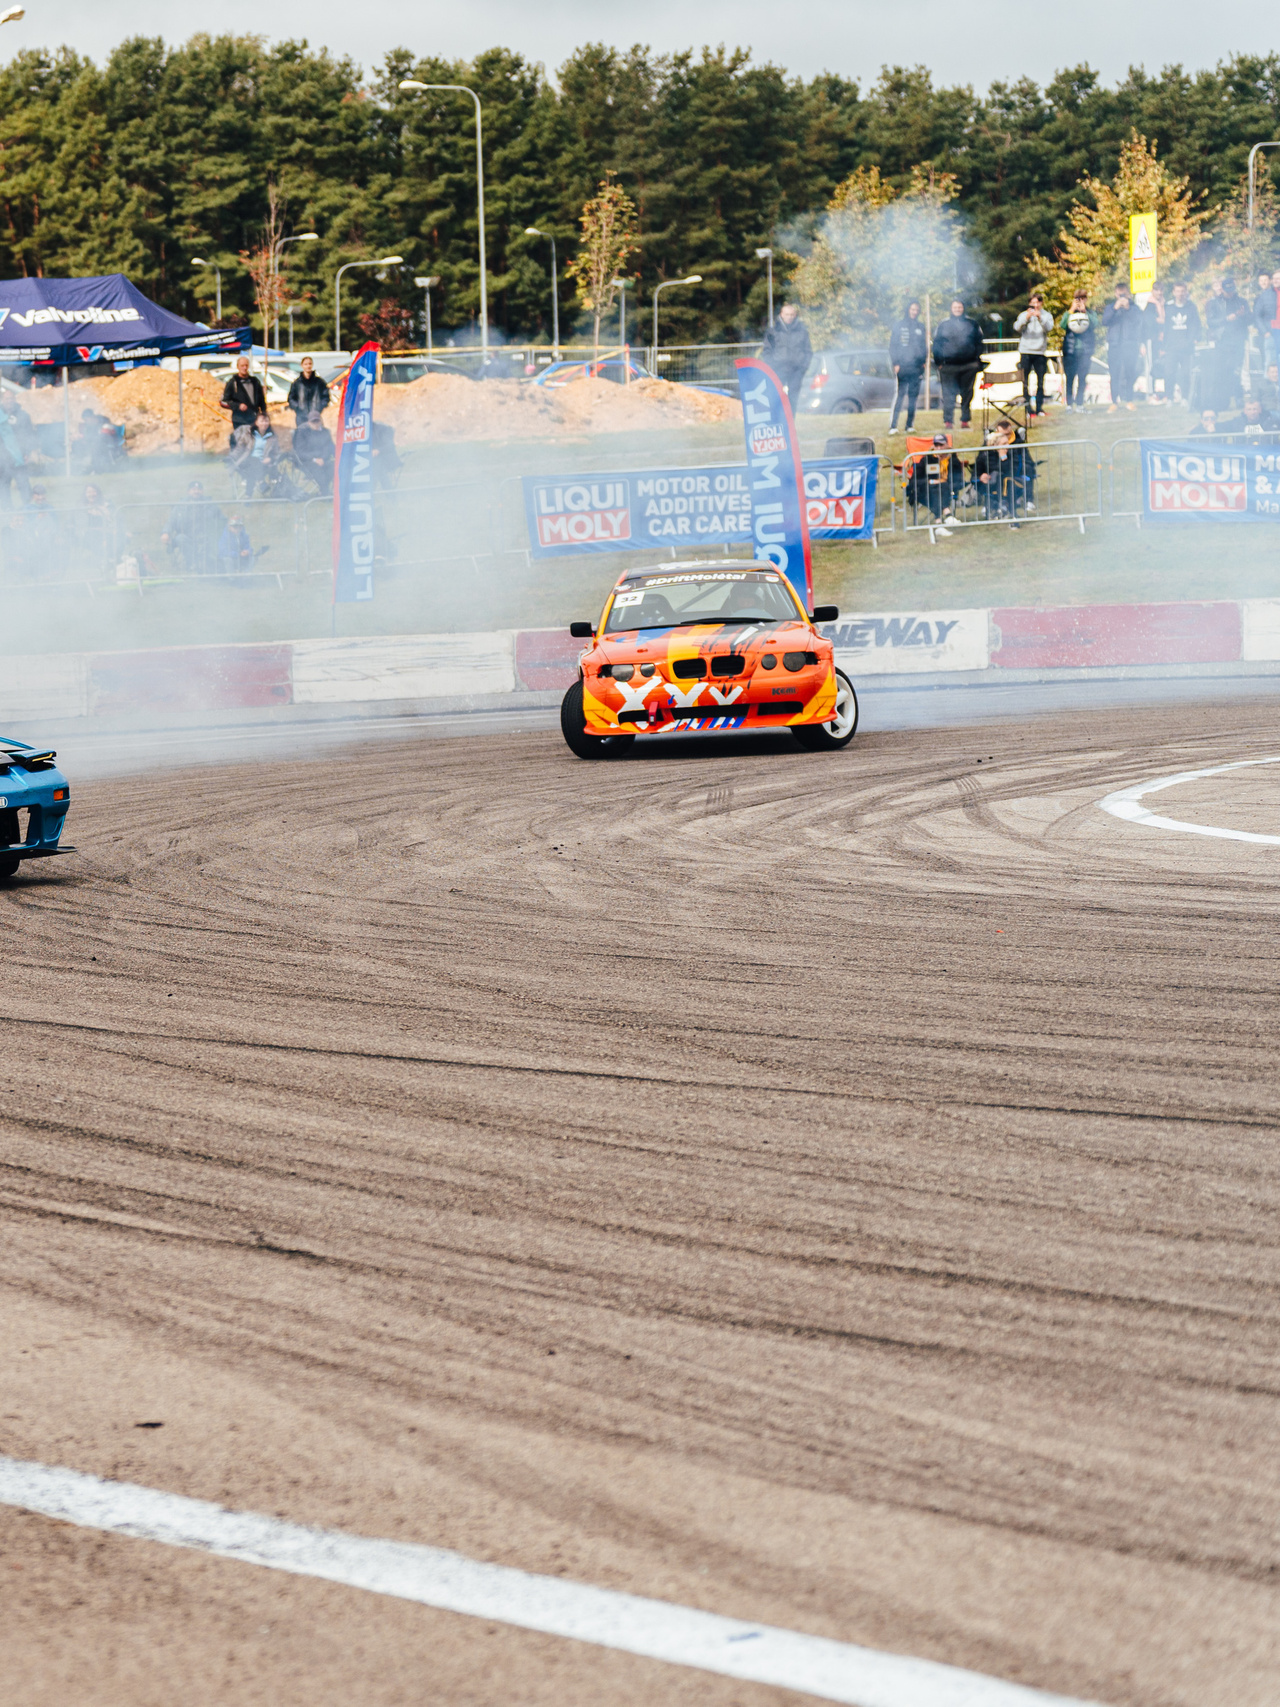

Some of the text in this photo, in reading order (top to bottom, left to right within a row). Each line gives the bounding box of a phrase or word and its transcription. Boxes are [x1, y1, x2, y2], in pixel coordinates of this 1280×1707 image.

[10, 306, 140, 328] Valvoline
[1153, 455, 1241, 482] LIQUI
[1255, 454, 1280, 472] M
[638, 475, 748, 497] MOTOR OIL
[805, 470, 862, 499] QUI
[1155, 483, 1243, 508] MOLY
[1255, 475, 1273, 494] &
[538, 482, 624, 515] LIQUI
[645, 494, 752, 516] ADDITIVES
[807, 498, 861, 527] OLY
[541, 510, 627, 544] MOLY
[648, 514, 751, 537] CAR CARE
[350, 492, 374, 600] LIQUI
[621, 595, 638, 603] 32
[819, 617, 959, 648] NEWAY
